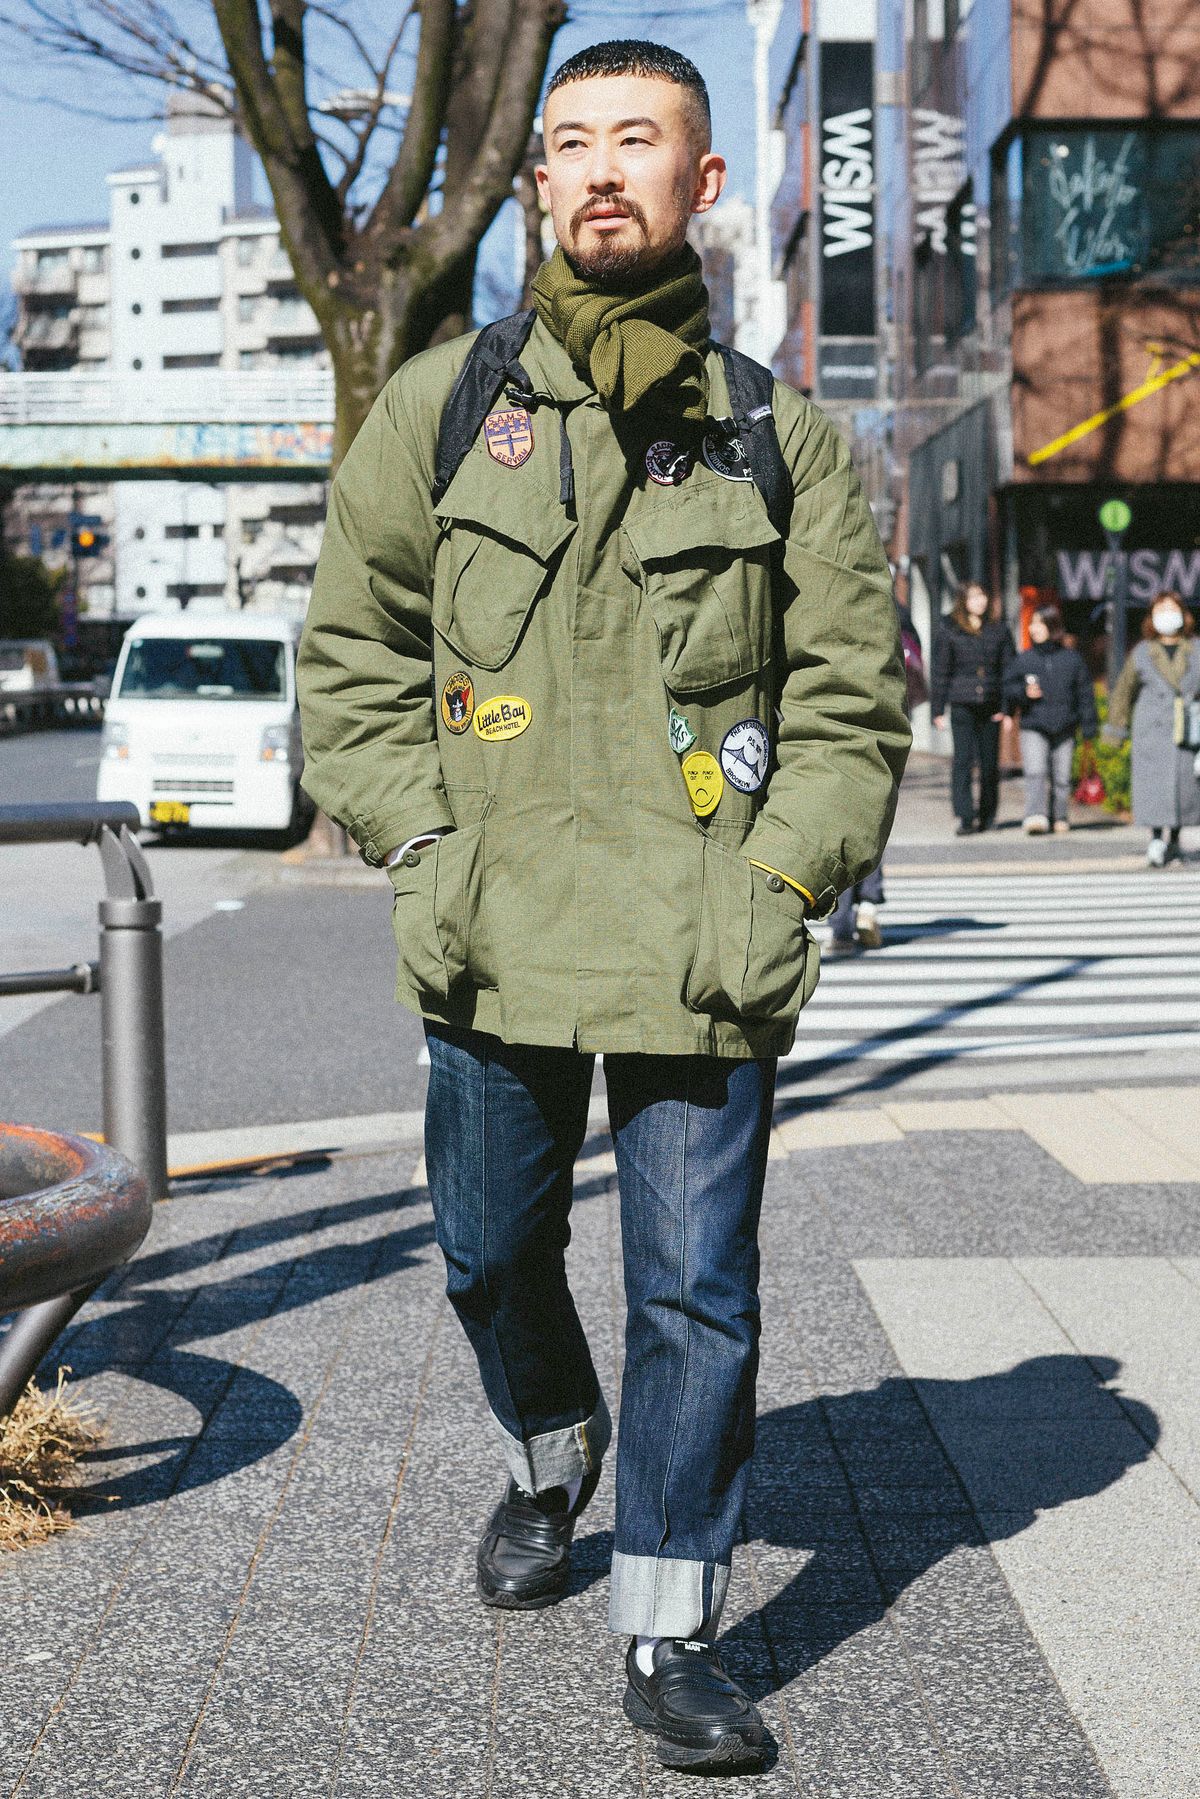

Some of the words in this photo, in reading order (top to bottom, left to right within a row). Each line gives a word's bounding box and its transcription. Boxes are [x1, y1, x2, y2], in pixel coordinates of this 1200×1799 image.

[823, 108, 872, 257] WISM
[708, 451, 731, 475] SCHOOL
[477, 710, 501, 731] Little
[501, 703, 526, 722] Bay
[486, 726, 504, 735] BEACH
[504, 721, 520, 730] HOTEL
[730, 726, 742, 738] THE
[725, 767, 751, 789] BROOKLYN
